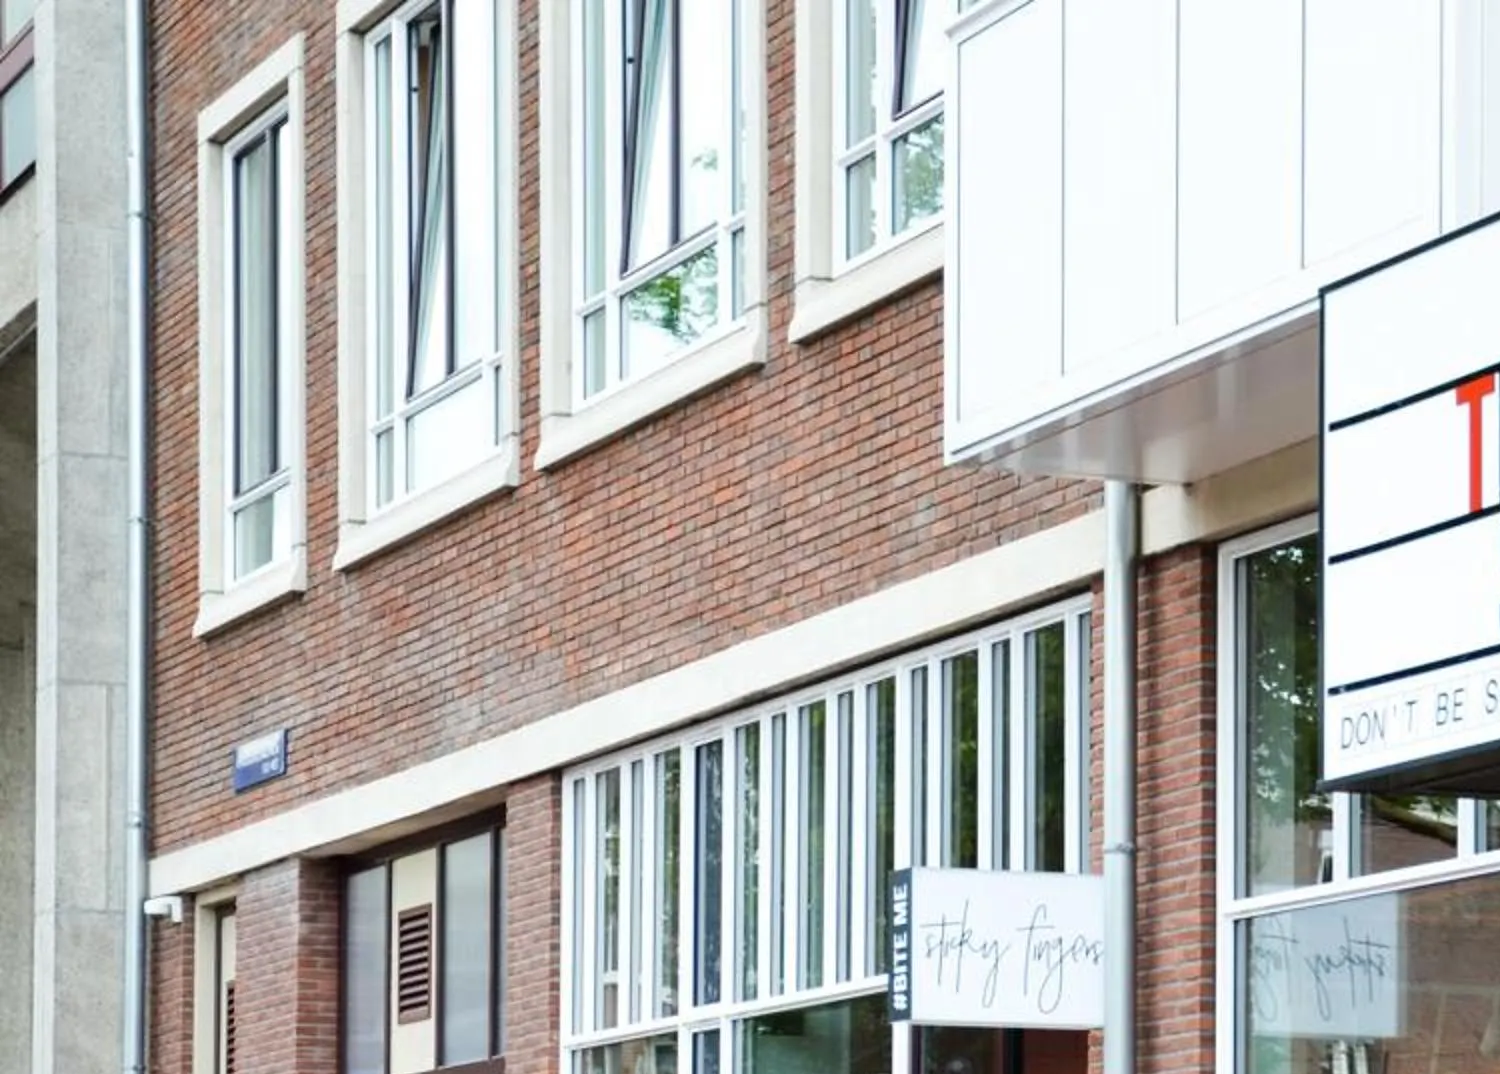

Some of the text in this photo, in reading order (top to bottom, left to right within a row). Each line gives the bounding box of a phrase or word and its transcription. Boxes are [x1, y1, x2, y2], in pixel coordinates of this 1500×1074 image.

[1341, 700, 1418, 749] DON'T
[1436, 688, 1464, 726] BE
[893, 884, 908, 1011] #BITE ME
